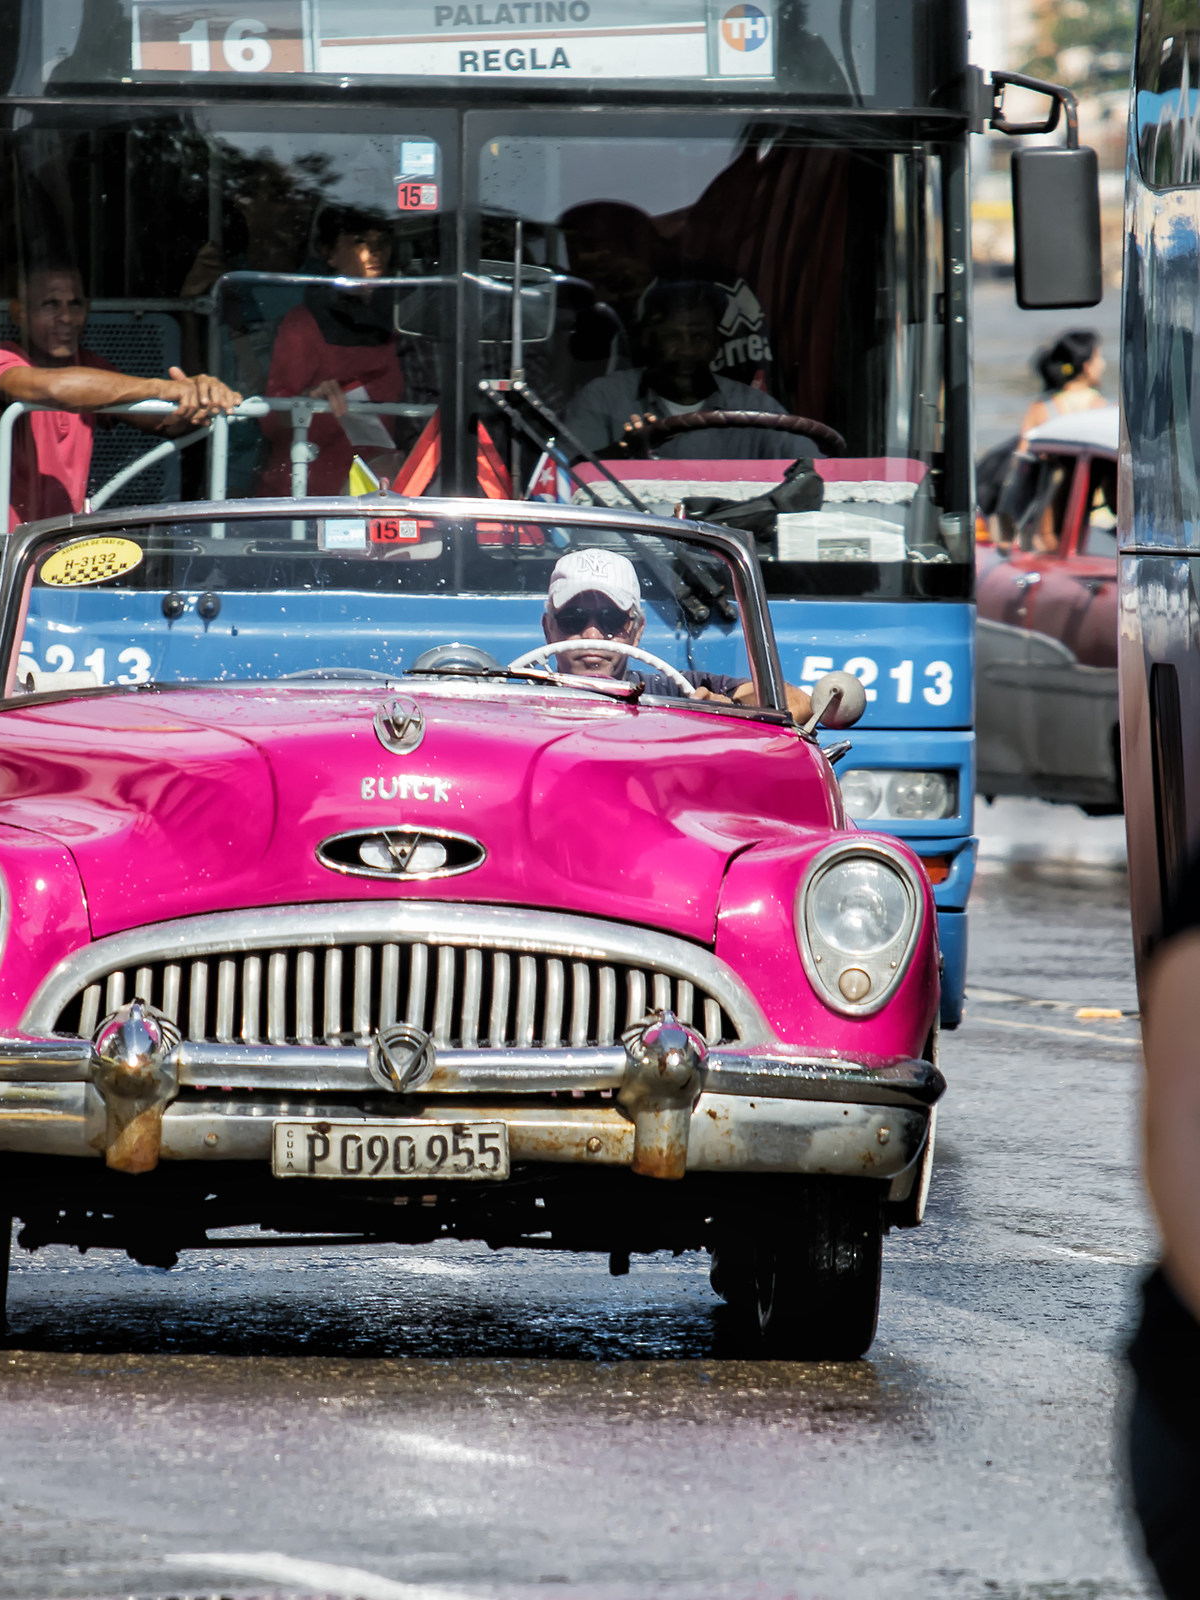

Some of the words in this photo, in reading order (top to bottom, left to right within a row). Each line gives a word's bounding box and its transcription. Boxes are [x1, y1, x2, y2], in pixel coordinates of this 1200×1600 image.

[434, 0, 591, 26] PALATINO
[726, 16, 767, 39] TH
[178, 19, 272, 72] 16
[458, 47, 572, 72] REGLA
[400, 185, 421, 207] 15
[373, 521, 398, 540] 15
[64, 552, 117, 570] H-3132
[577, 553, 612, 578] NY
[800, 655, 953, 706] 5213
[361, 775, 450, 802] BUICK
[286, 1130, 294, 1168] CUBA
[307, 1132, 330, 1174] P
[340, 1133, 416, 1175] 090
[426, 1132, 501, 1174] 955
